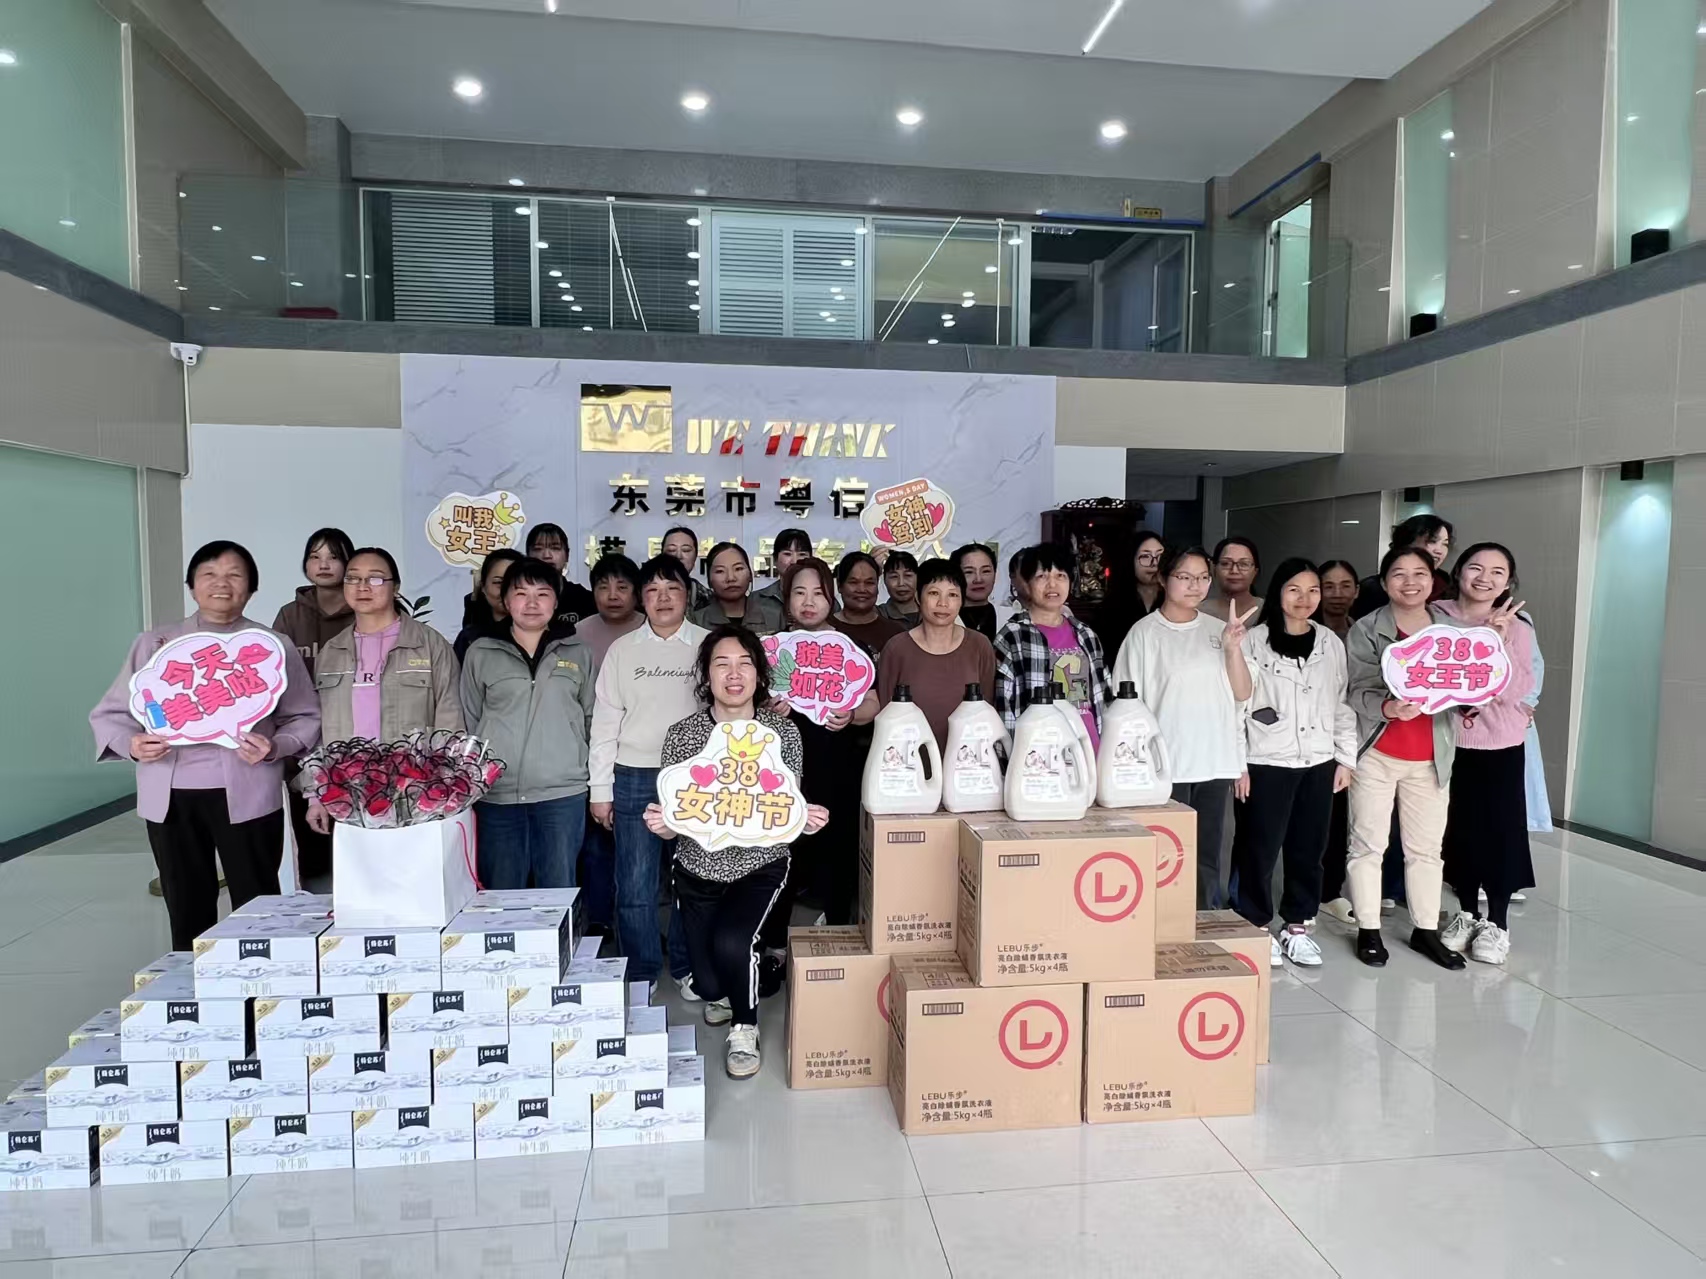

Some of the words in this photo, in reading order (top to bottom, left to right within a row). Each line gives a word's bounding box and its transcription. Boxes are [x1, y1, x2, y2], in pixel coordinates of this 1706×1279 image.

[608, 472, 869, 519] 东莞市粤信
[911, 482, 926, 493] DAY
[453, 505, 494, 530] 叫我
[885, 495, 927, 527] 女神
[445, 526, 498, 556] 女王
[891, 514, 934, 546] 驾到
[794, 640, 844, 672] 貌美
[1433, 637, 1472, 661] 38
[160, 643, 234, 690] 今天
[1404, 660, 1493, 691] 女王节
[160, 664, 269, 730] 美美哒
[788, 671, 845, 702] 如花
[717, 757, 760, 787] 38
[673, 783, 794, 830] 女神节
